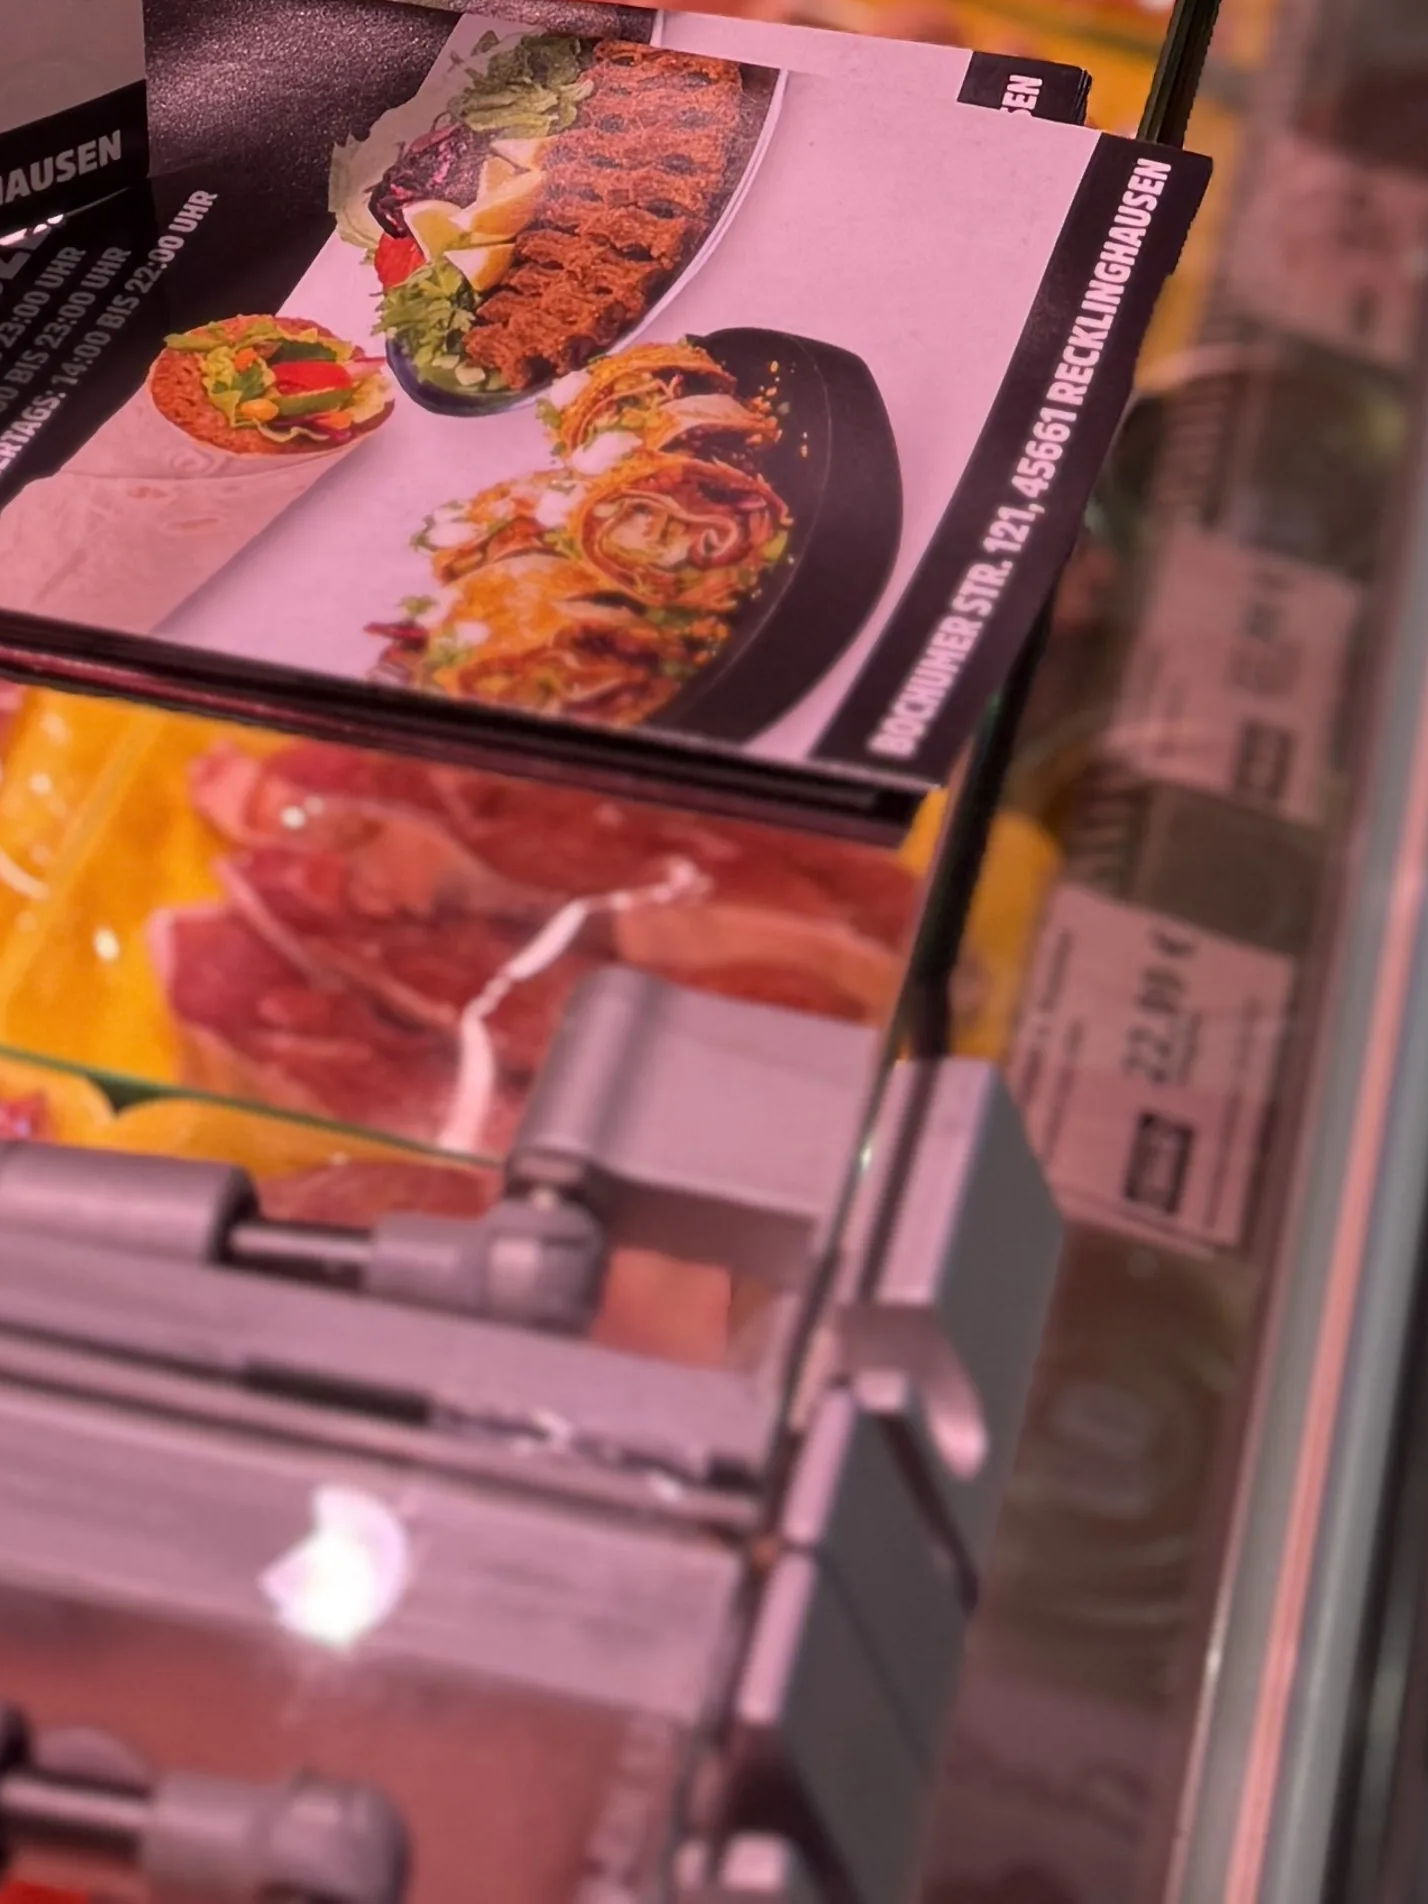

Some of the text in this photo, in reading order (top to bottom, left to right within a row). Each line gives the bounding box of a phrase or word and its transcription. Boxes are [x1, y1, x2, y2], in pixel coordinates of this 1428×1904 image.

[1001, 74, 1043, 117] EN
[3, 348, 49, 385] BIS
[34, 290, 97, 350] 23:00
[80, 246, 133, 291] UHR
[34, 245, 87, 289] UHR
[52, 327, 112, 386] 14:00
[95, 293, 141, 330] BIS
[123, 233, 185, 294] 22:00
[168, 189, 219, 233] UHR
[867, 157, 1172, 759] BOCHUMER STR. 121, 45661 RECKLINGHAUSEN
